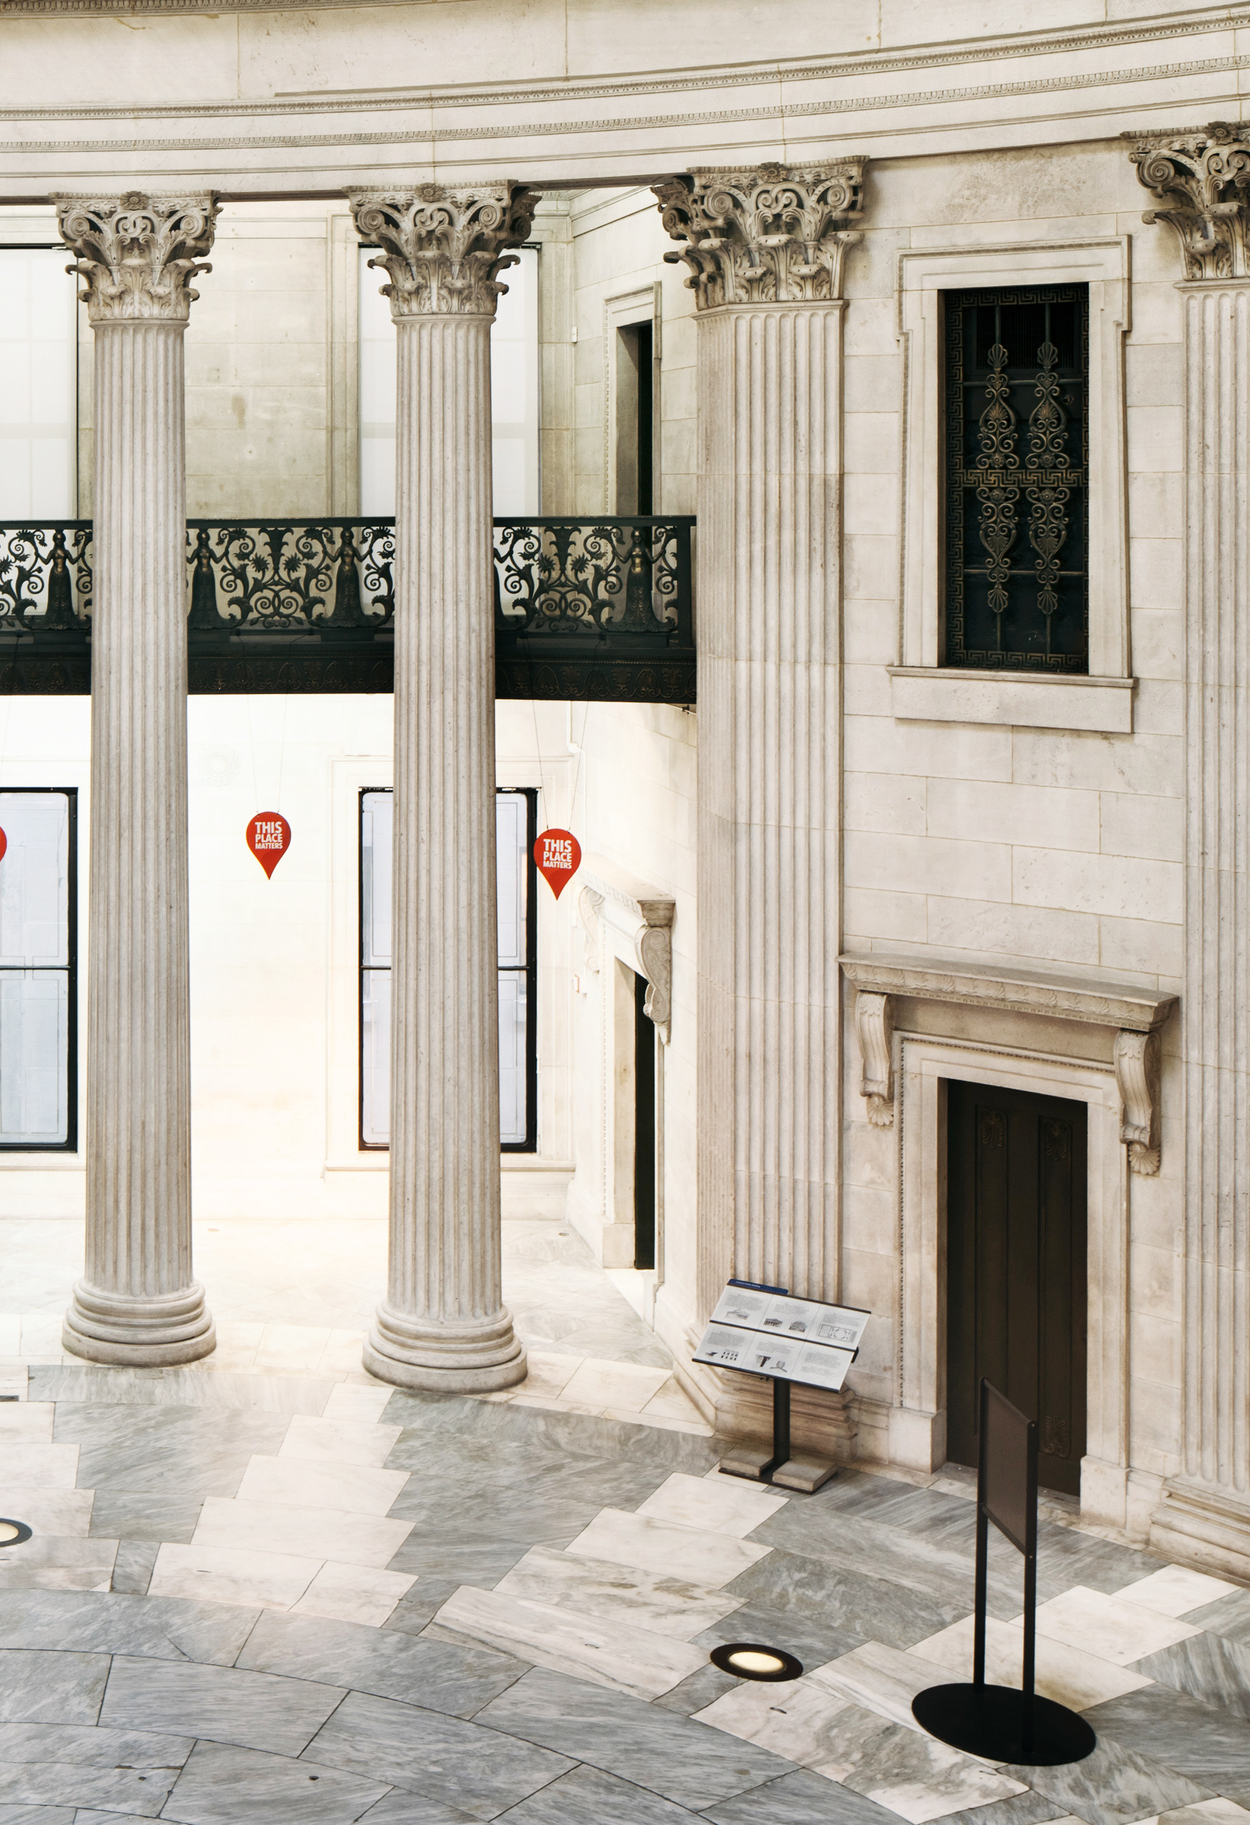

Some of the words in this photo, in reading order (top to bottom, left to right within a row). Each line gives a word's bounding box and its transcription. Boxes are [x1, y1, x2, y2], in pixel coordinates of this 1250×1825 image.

[254, 821, 282, 834] THIS
[254, 833, 282, 843] PLACE
[254, 841, 282, 850] MATTERS
[543, 838, 571, 853] THIS
[543, 851, 571, 862] PLACE
[543, 859, 571, 869] MATTERS
